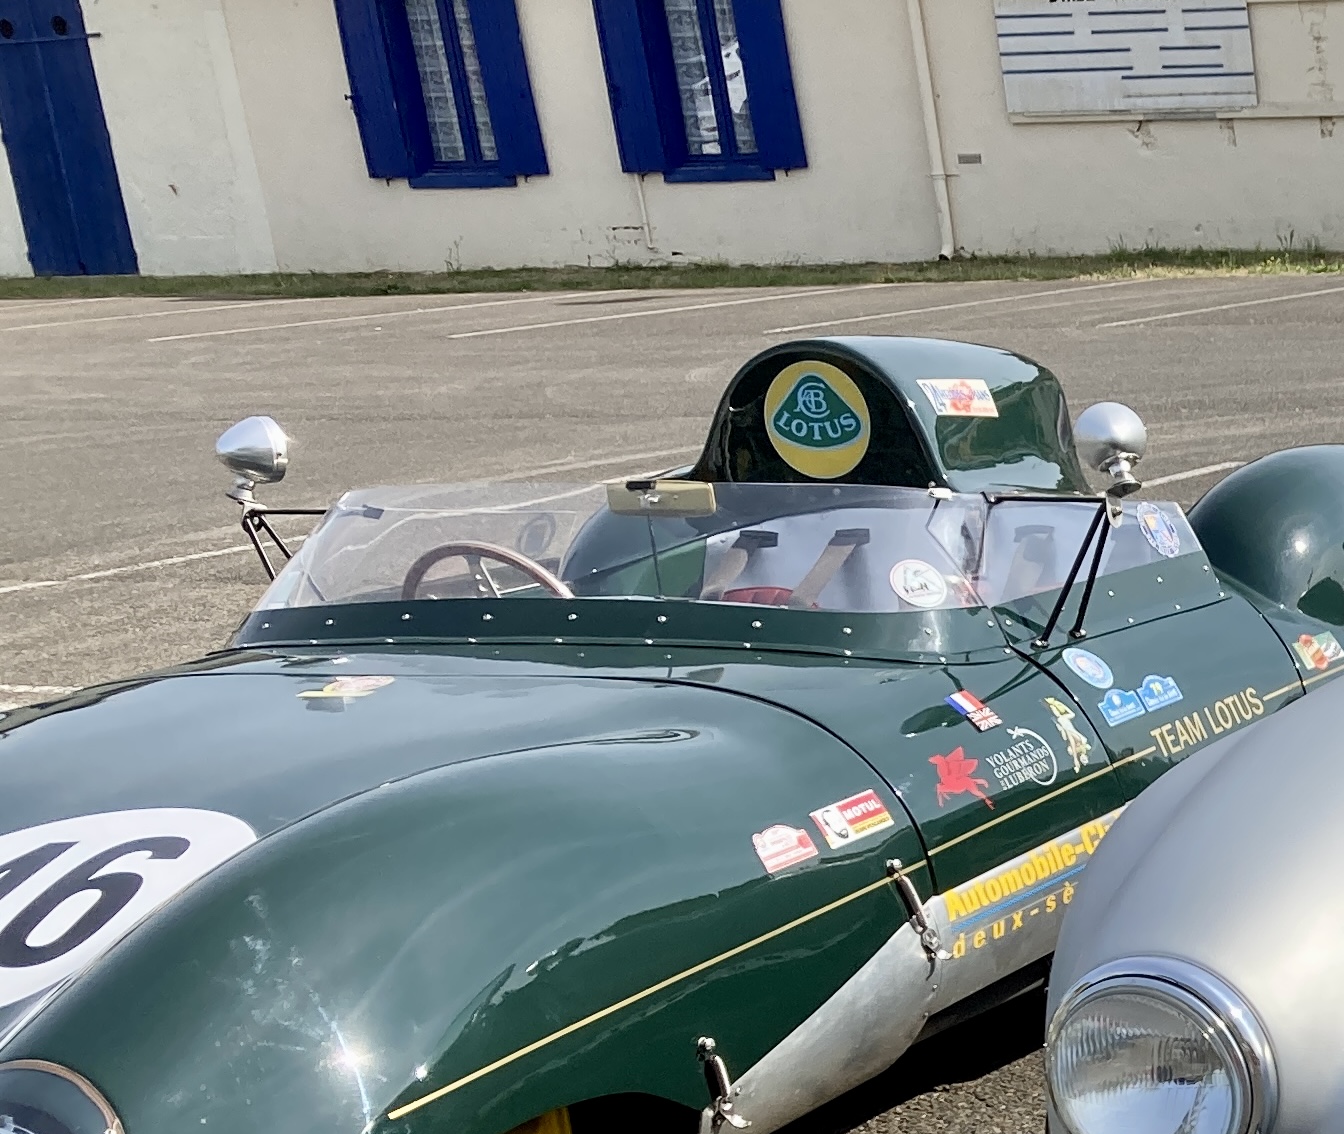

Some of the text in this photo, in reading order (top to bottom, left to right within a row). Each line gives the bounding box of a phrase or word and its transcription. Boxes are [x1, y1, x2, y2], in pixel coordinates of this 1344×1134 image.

[776, 410, 857, 441] LOTUS
[1150, 687, 1264, 757] TEAM LOTUS
[985, 739, 1034, 768] VOLANTS
[993, 745, 1050, 779] GOURMANDS
[1003, 758, 1050, 790] LUBERON
[841, 799, 881, 821] MOTUL
[952, 881, 1075, 959] deux-sè
